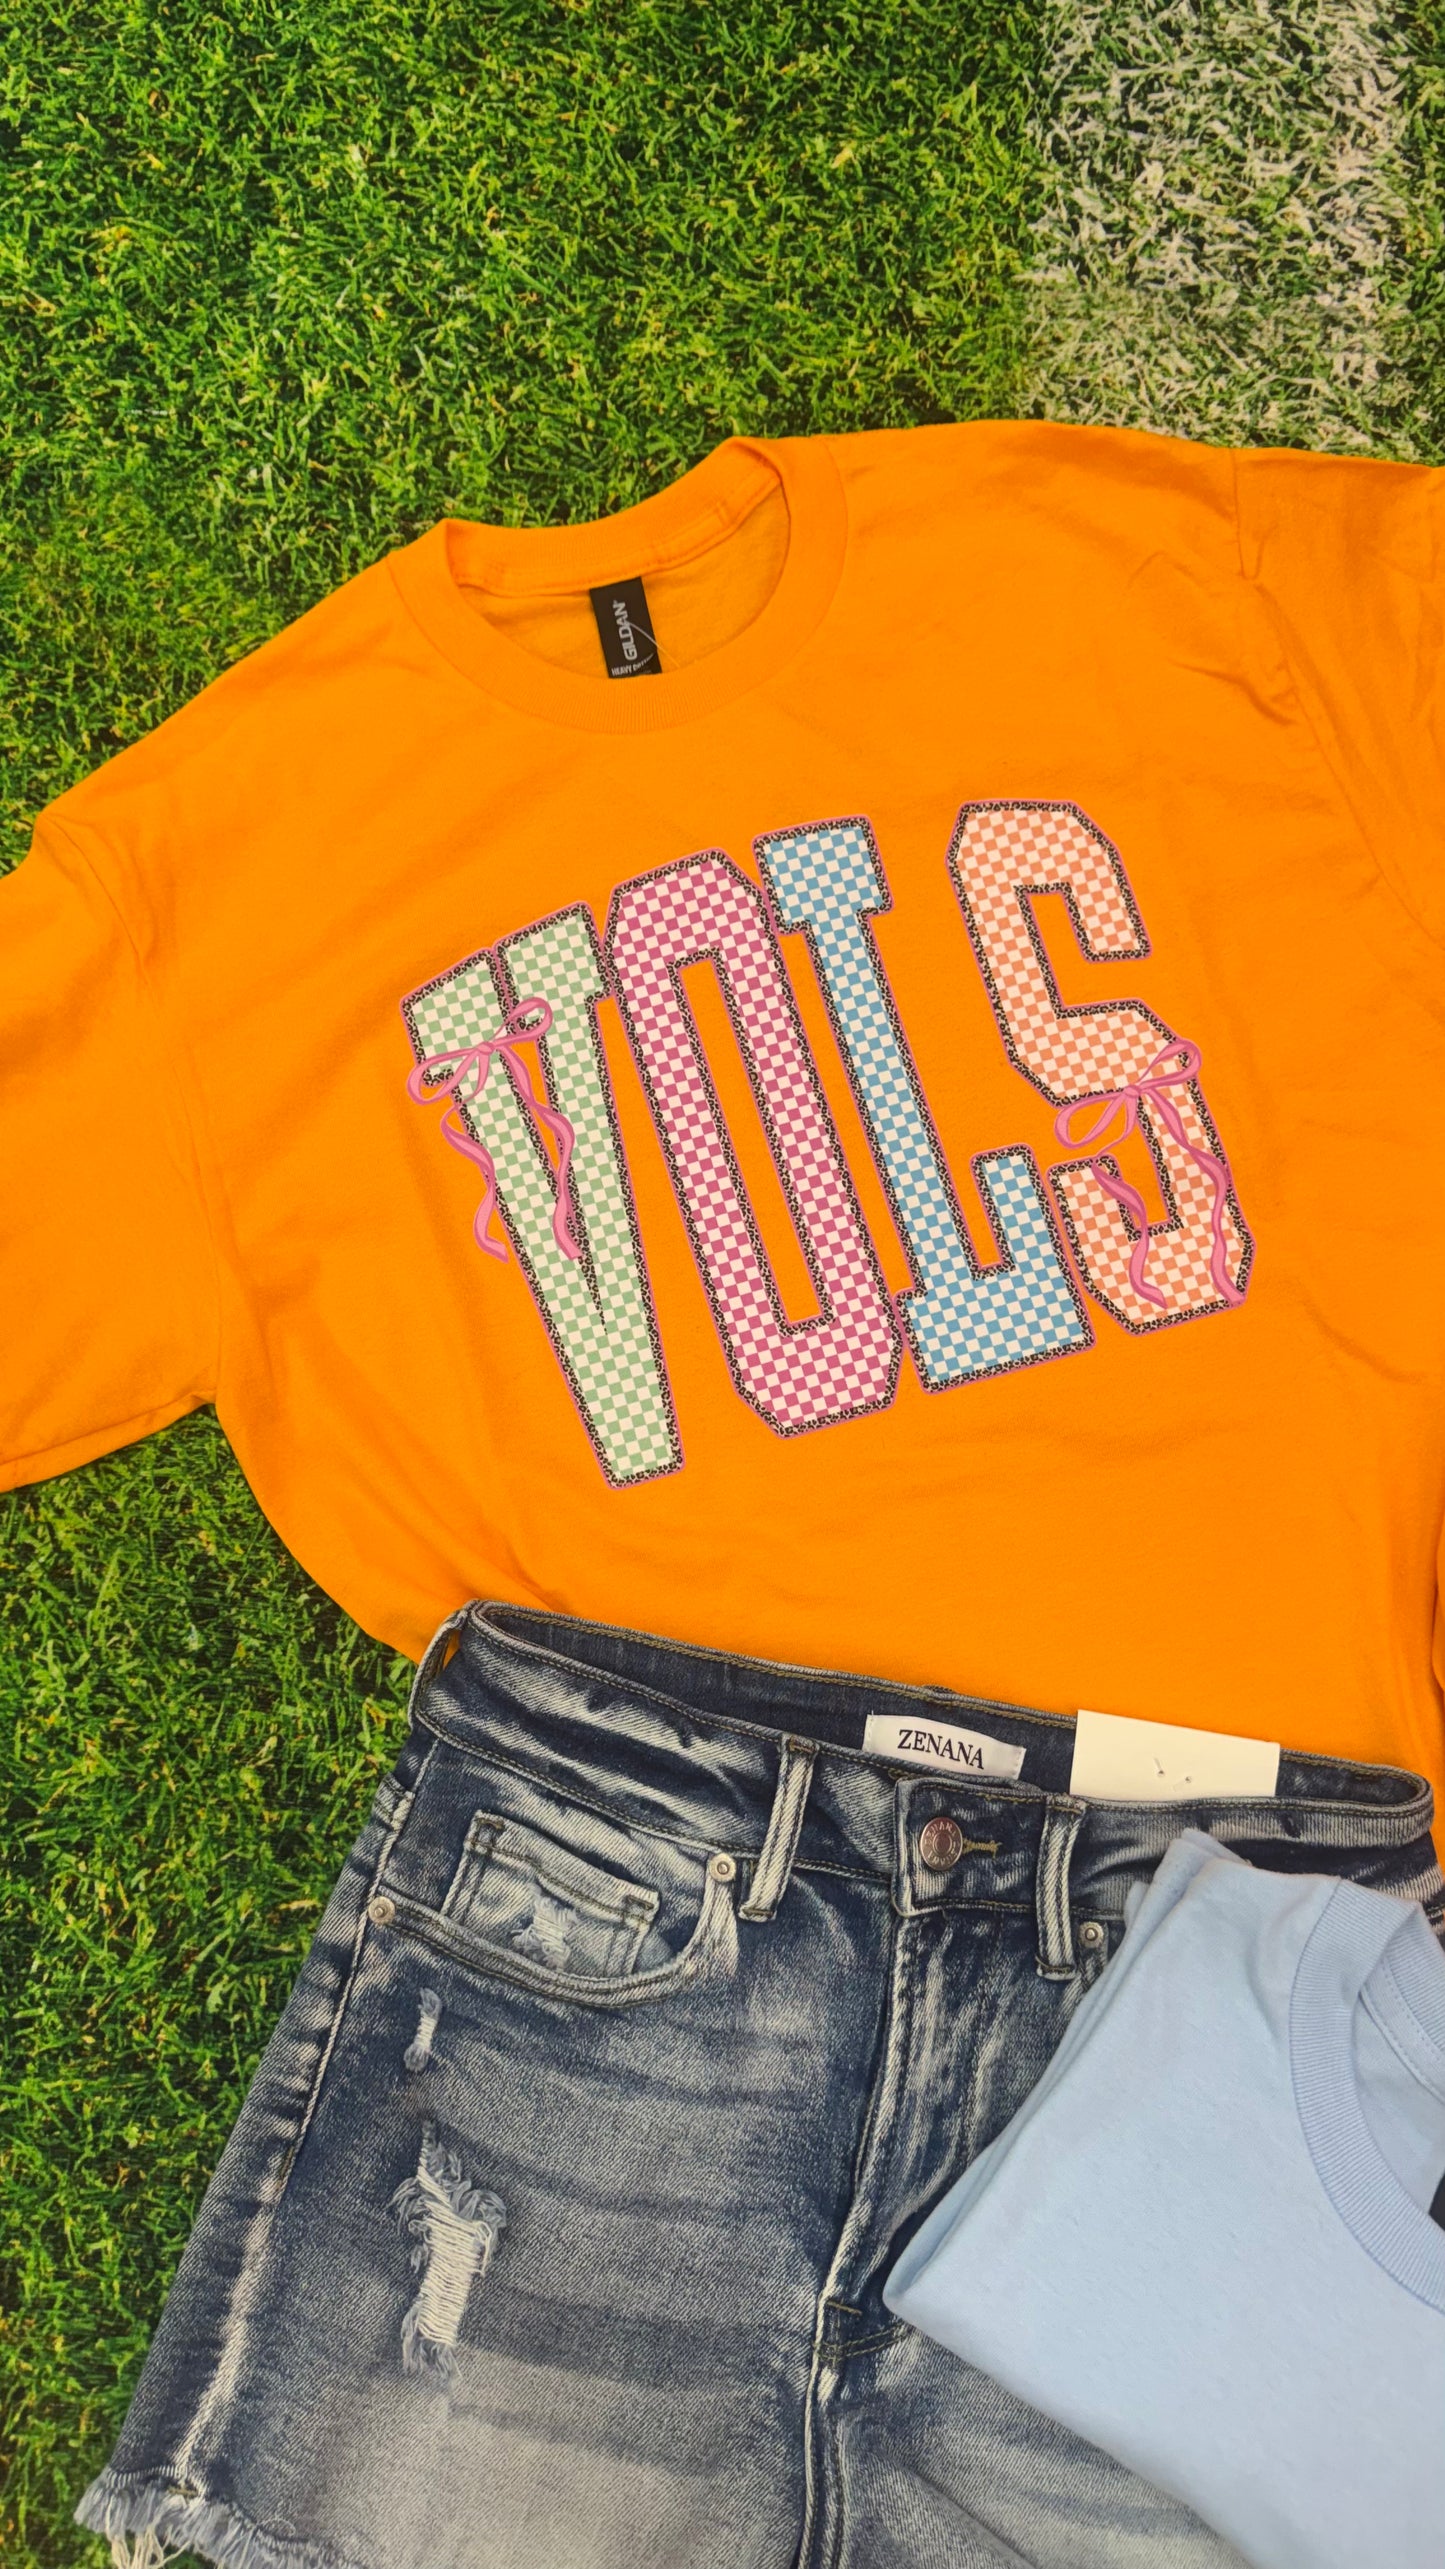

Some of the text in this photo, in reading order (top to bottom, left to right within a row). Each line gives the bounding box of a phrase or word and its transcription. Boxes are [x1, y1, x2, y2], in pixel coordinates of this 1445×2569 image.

[612, 600, 638, 661] GILDAN
[611, 664, 632, 676] HEAVY
[400, 799, 1256, 1491] VOLS
[897, 1729, 985, 1770] ZENANA
